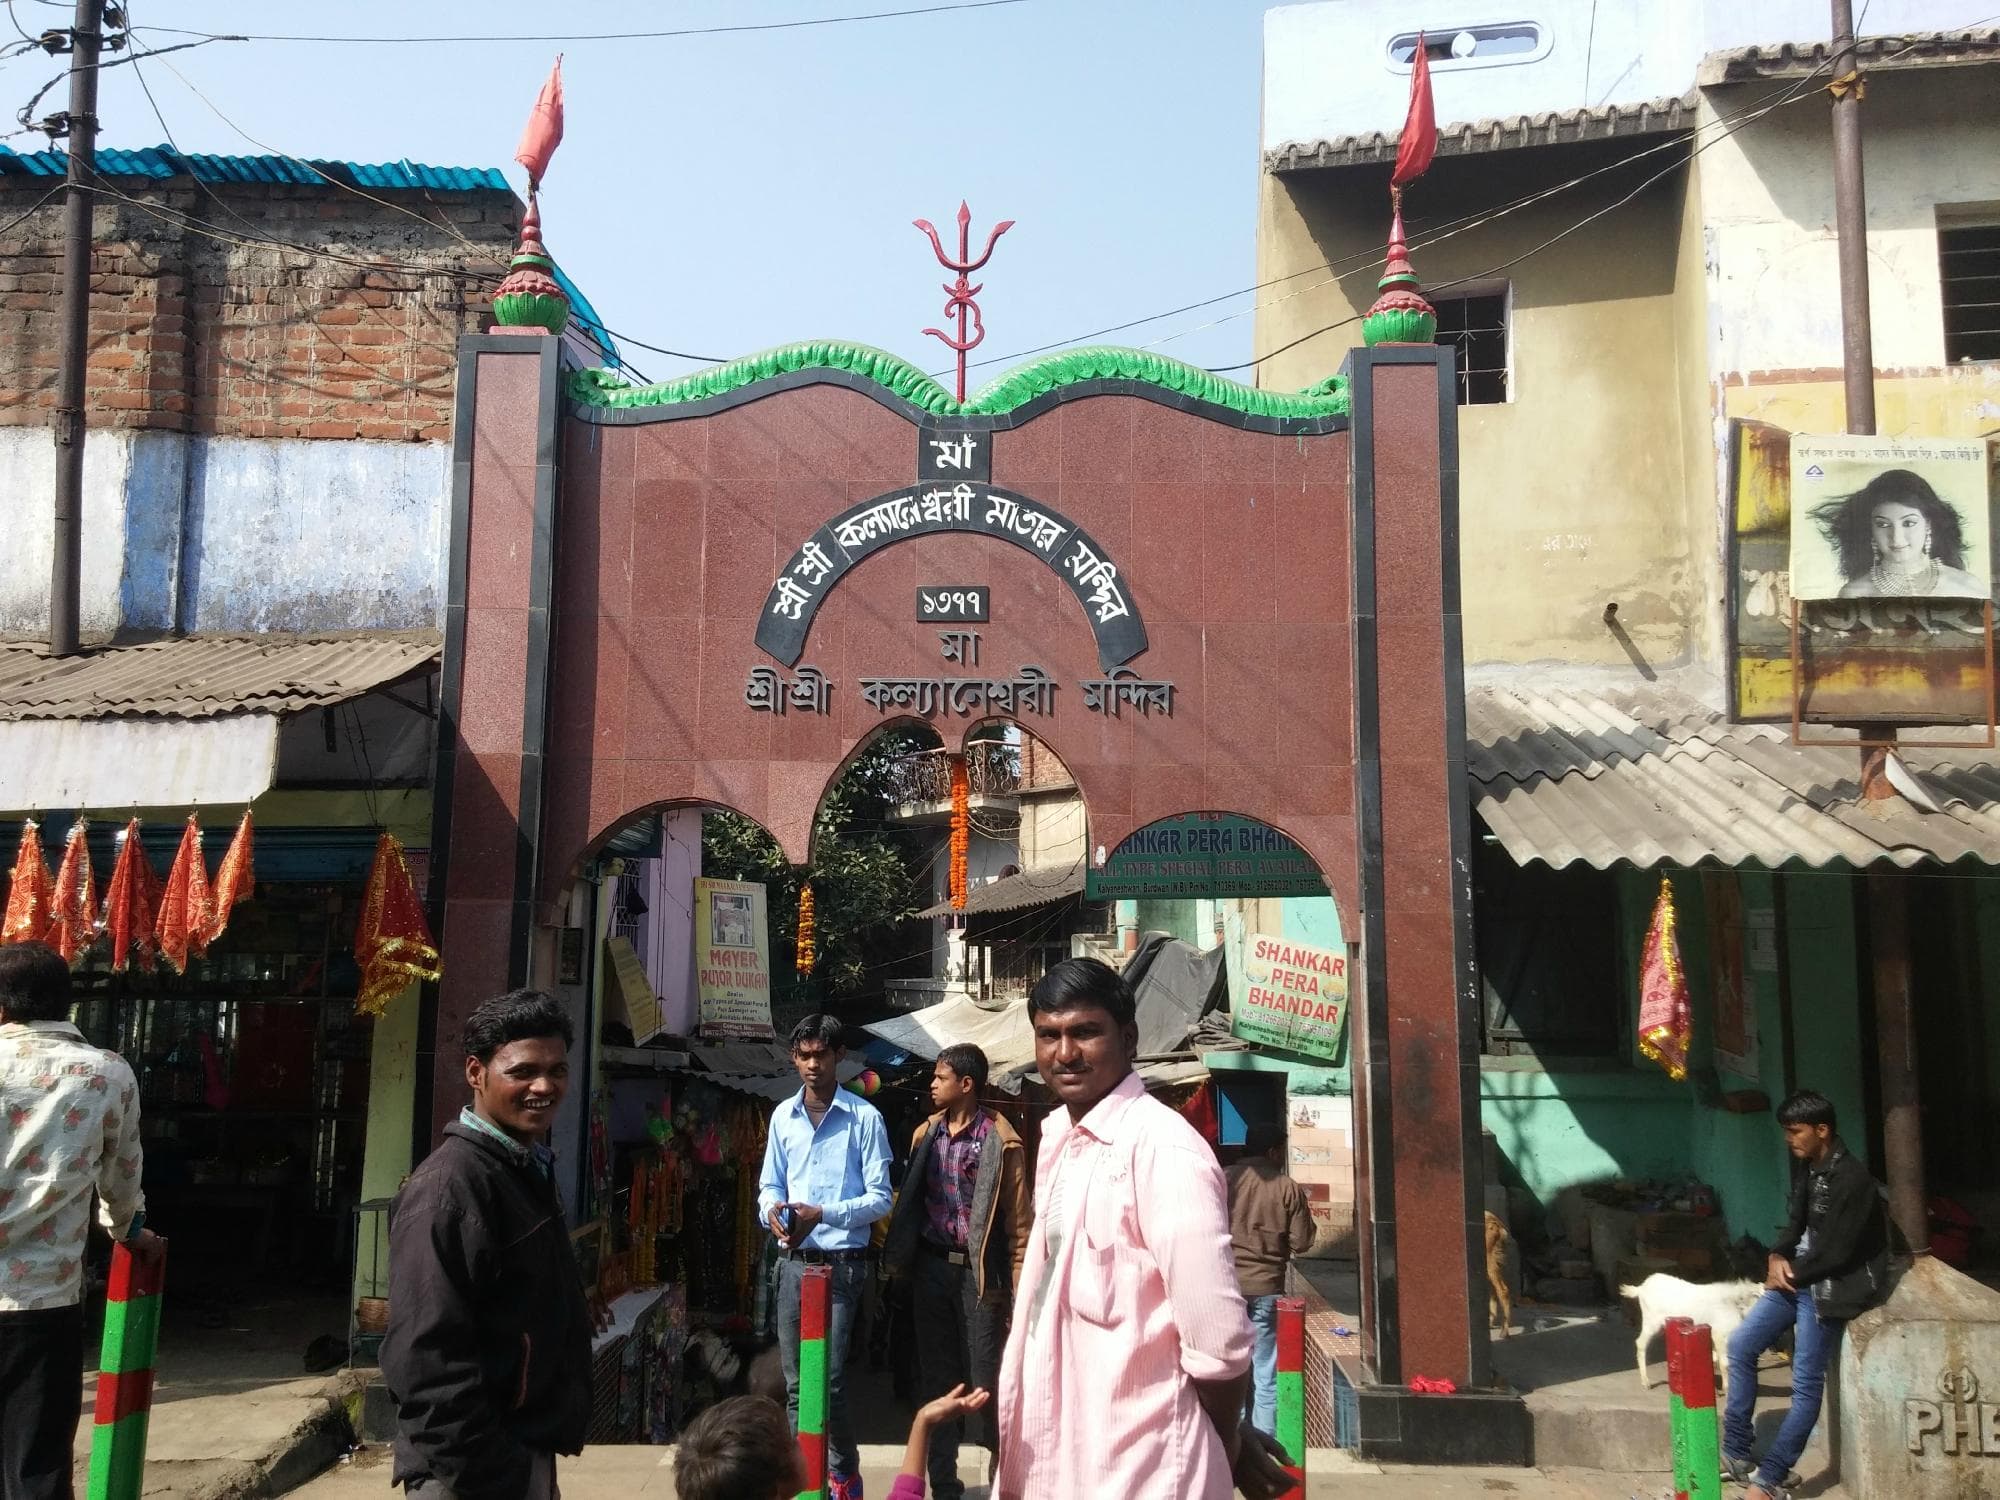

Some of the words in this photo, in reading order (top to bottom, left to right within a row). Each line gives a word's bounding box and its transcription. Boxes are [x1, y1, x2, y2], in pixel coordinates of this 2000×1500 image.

[772, 577, 813, 619] শ্রী
[793, 541, 834, 585] শ্রী
[985, 495, 1068, 552] মাতার
[1064, 539, 1130, 624] মন্দির
[921, 590, 981, 616] ১৩৭৭
[936, 628, 981, 665] মা
[1079, 666, 1175, 716] মন্দির
[1117, 829, 1182, 856] ANKAR
[1187, 828, 1233, 856] PERA
[1238, 827, 1297, 855] BHAN
[1123, 861, 1155, 877] TYPE
[1160, 860, 1213, 877] SPECIAL
[1217, 860, 1252, 876] PERA
[709, 949, 759, 969] MAYER
[1254, 940, 1346, 978] SHANKAR
[700, 969, 733, 988] PUJOR
[735, 971, 768, 990] DUKAN
[1271, 967, 1320, 996] PERA
[1247, 986, 1339, 1025] BHANDAR
